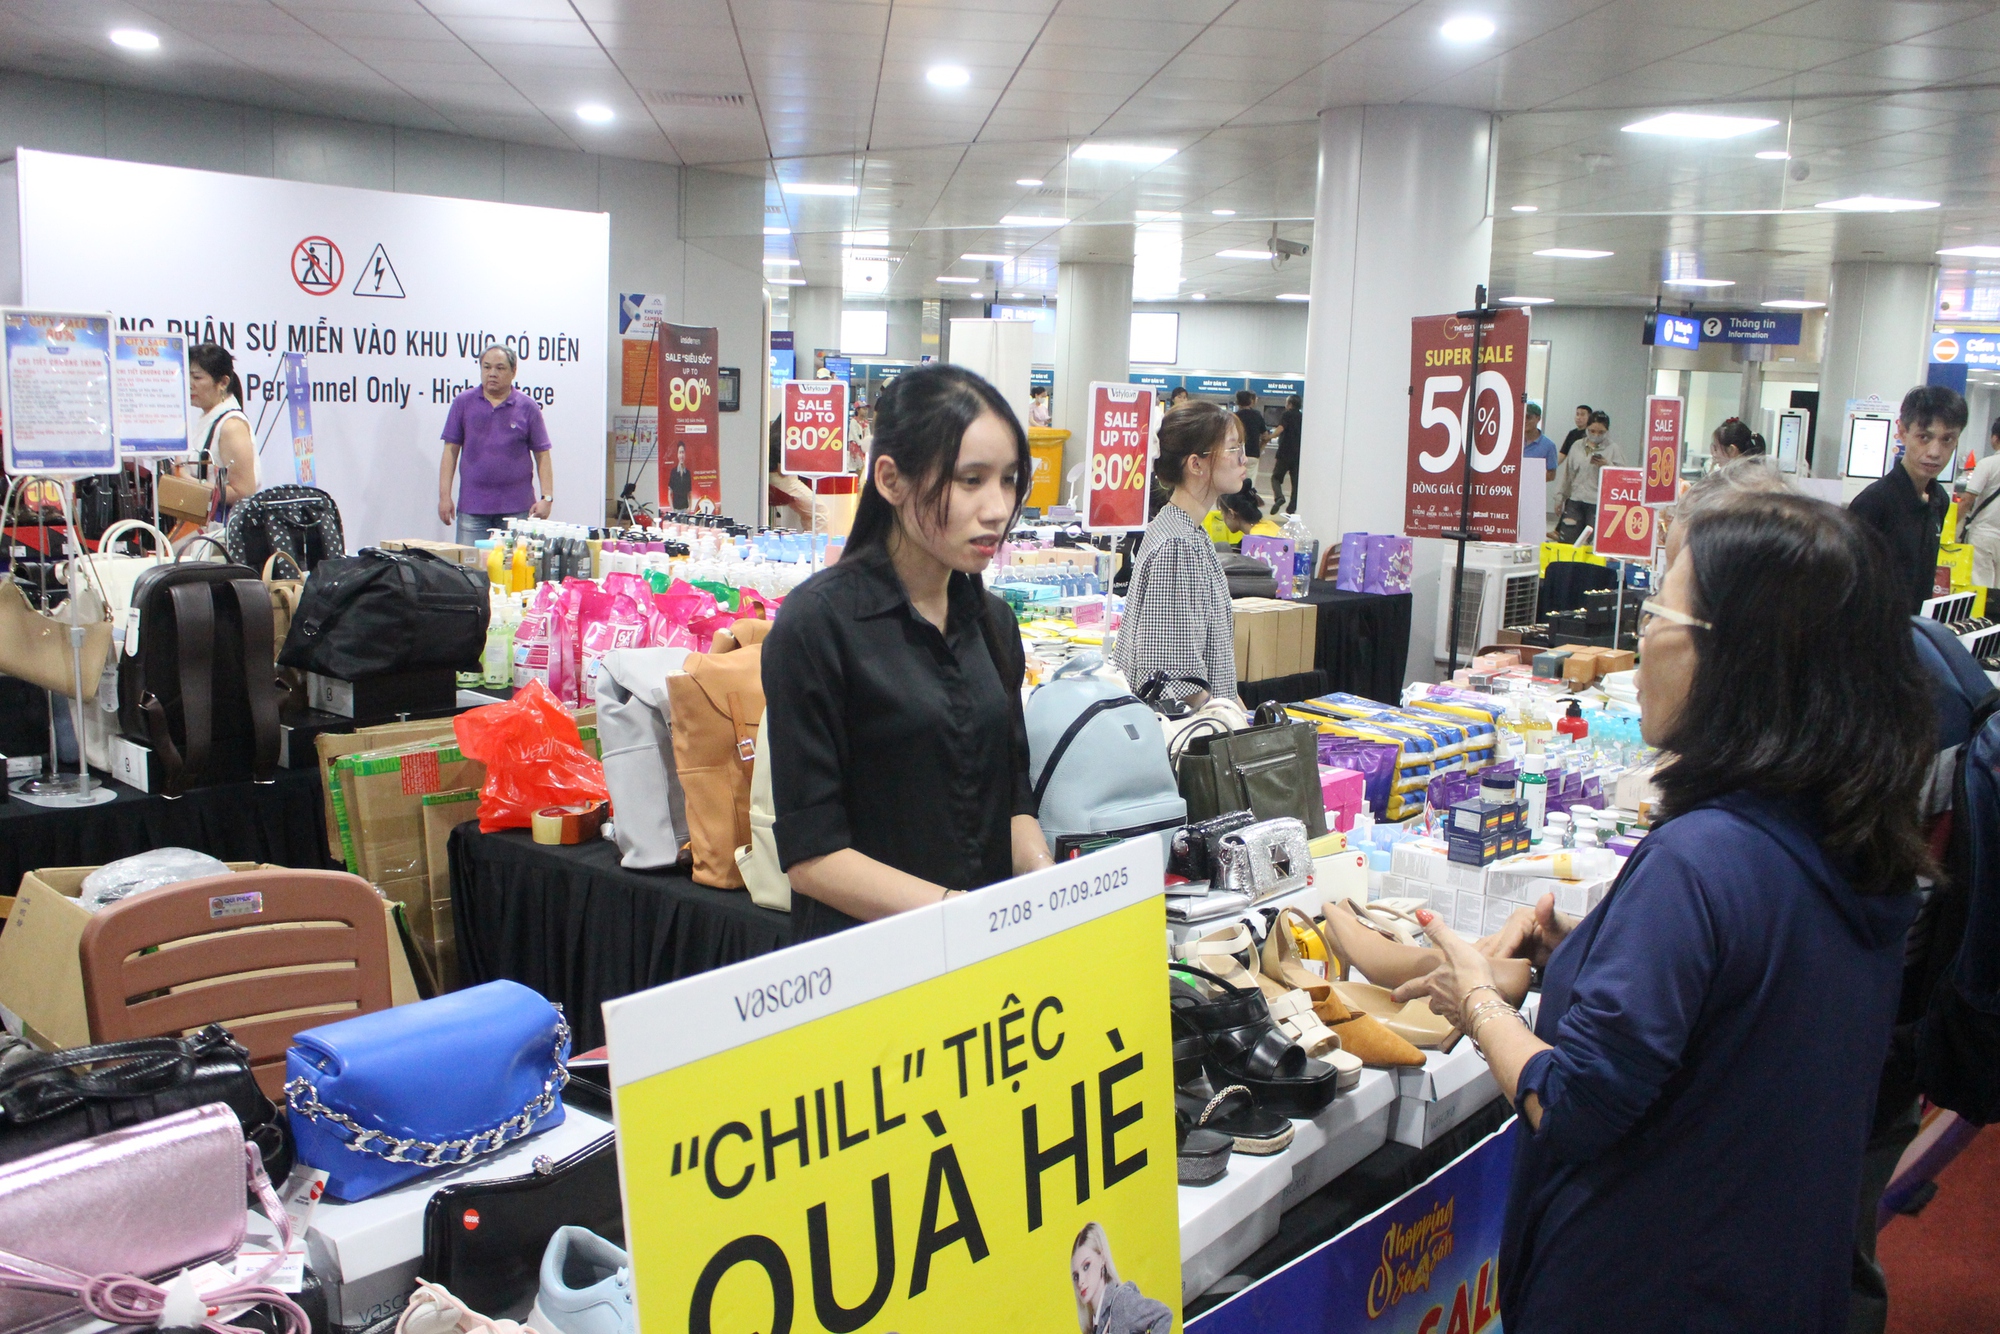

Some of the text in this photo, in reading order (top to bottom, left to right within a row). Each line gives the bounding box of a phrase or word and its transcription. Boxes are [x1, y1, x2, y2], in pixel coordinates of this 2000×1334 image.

[1730, 317, 1776, 330] Thông tin
[246, 320, 277, 357] SỰ
[288, 317, 343, 354] MIỄN
[353, 323, 396, 356] VÀO
[407, 329, 447, 358] KHU
[538, 332, 580, 367] ĐIỆN
[1966, 338, 1995, 352] Cấm
[665, 352, 682, 363] SALE
[1425, 345, 1514, 366] SUPER SALE
[1964, 354, 1978, 363] No
[691, 368, 698, 376] TO
[246, 373, 356, 403] Pernnel
[367, 376, 411, 410] Only
[669, 377, 711, 412] 80%
[797, 400, 832, 411] SALE
[794, 412, 835, 423] UP TO
[1104, 412, 1138, 428] SALE
[1654, 419, 1673, 432] SALE
[786, 426, 842, 451] 80%
[1100, 430, 1139, 447] UP TO
[1091, 453, 1144, 491] 80%
[1501, 464, 1516, 474] OFF
[1648, 446, 1675, 488] 30
[1412, 481, 1438, 494] ĐỒNG
[1440, 482, 1454, 494] GIÁ
[1475, 483, 1488, 496] TỪ
[1489, 485, 1513, 496] 699K
[1490, 512, 1510, 520] TIMEX
[1603, 504, 1650, 541] 70
[988, 899, 1032, 933] 27.08
[1049, 866, 1129, 911] 07.09.2025
[734, 966, 833, 1022] vascara
[943, 993, 1066, 1099] TIỆC
[688, 1027, 1148, 1334] QUÀ HÈ
